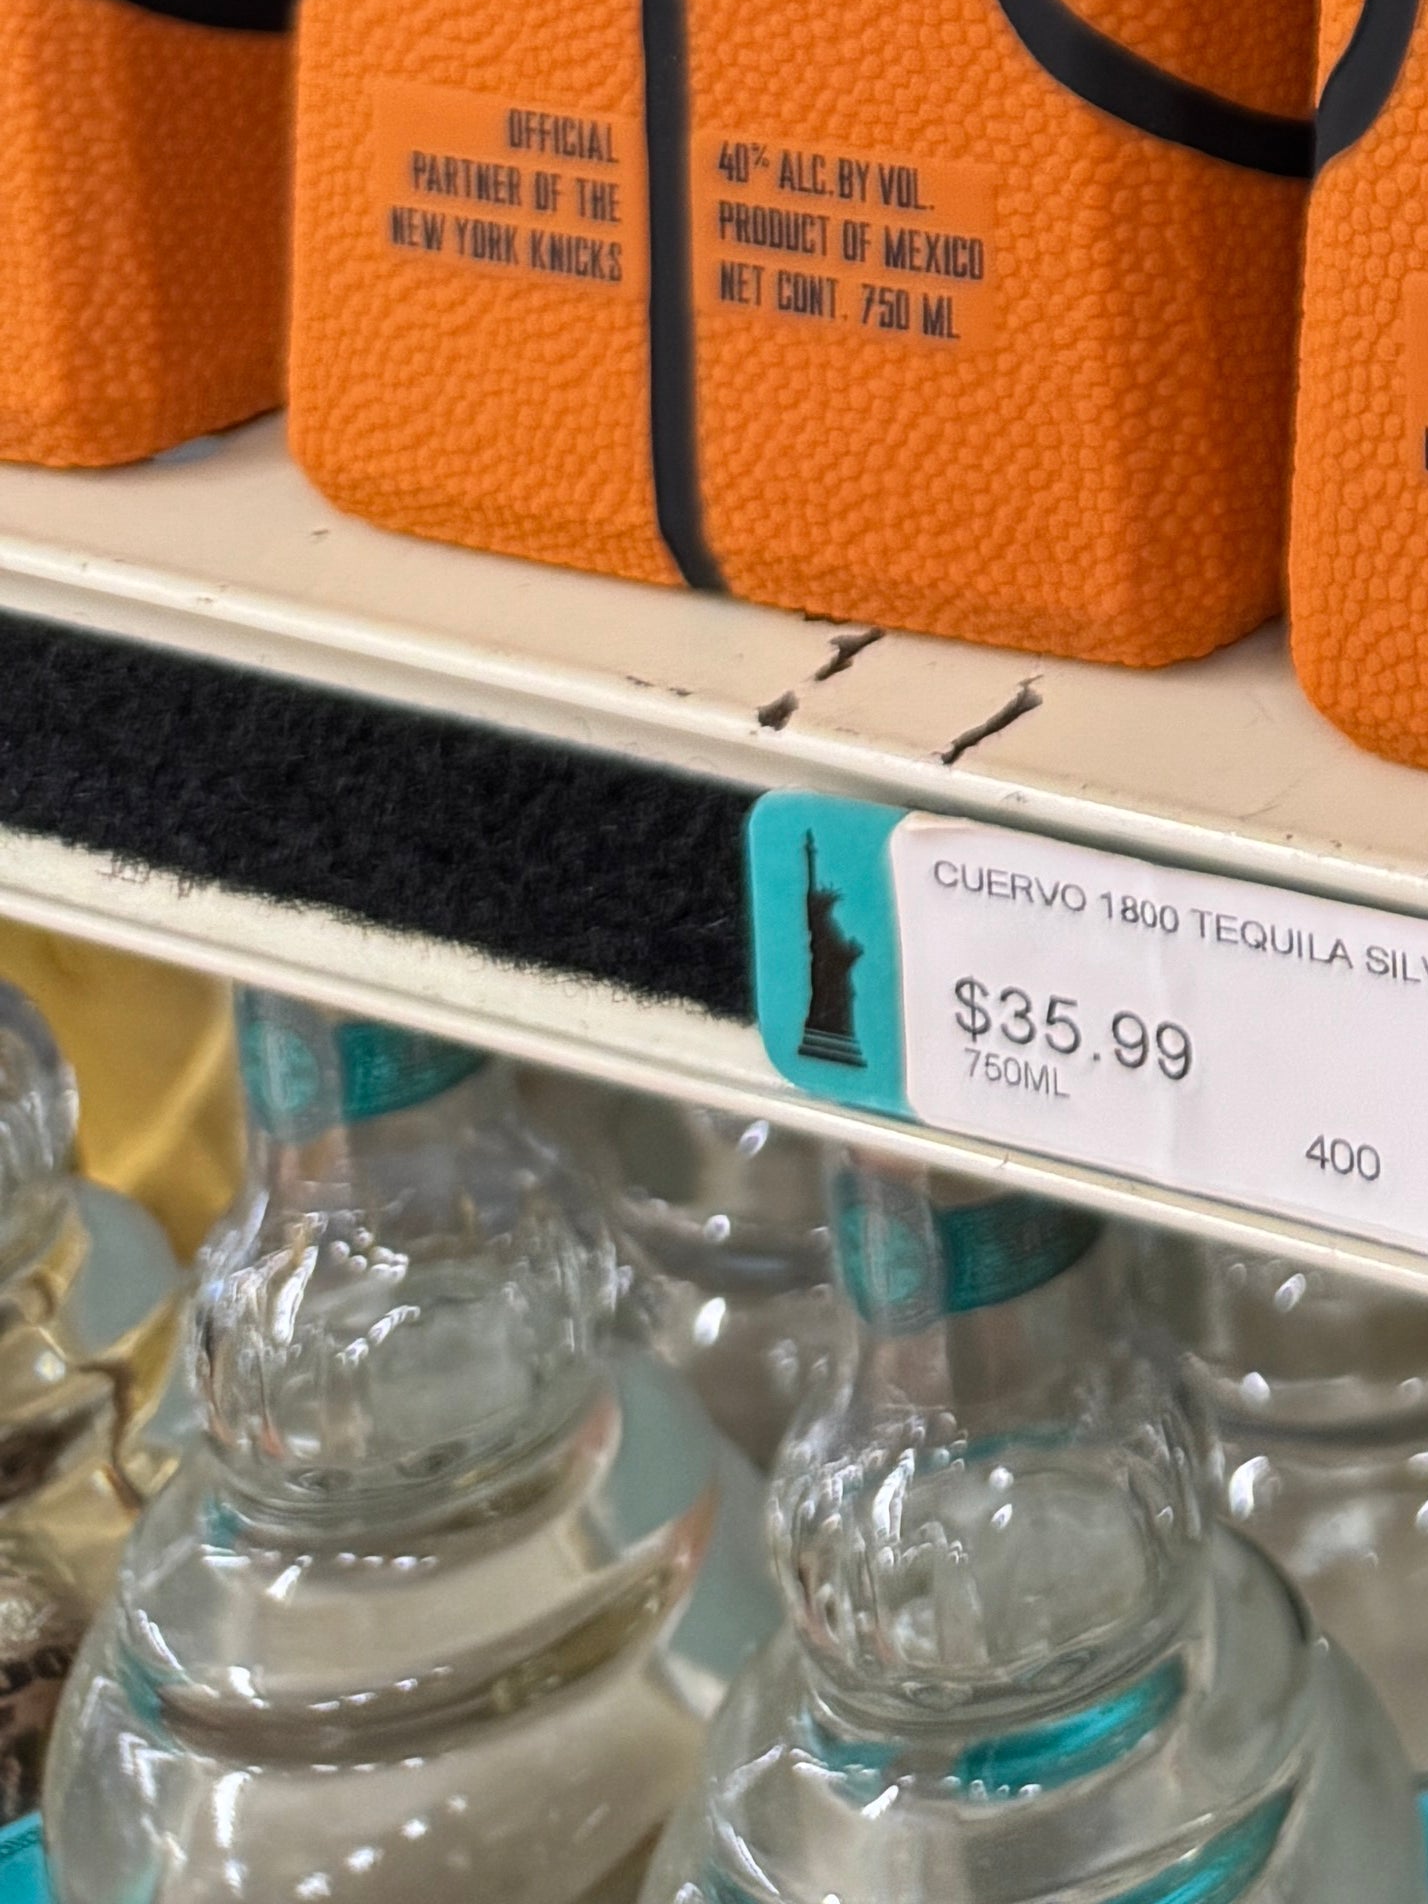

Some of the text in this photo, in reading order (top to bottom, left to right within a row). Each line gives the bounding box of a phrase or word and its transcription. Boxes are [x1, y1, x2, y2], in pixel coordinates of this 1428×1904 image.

[508, 108, 619, 164] OFFICIAL
[411, 150, 622, 224] PARTNER OF THE
[718, 140, 770, 184] 40%
[878, 166, 935, 211] VOL.
[389, 205, 623, 283] NEW YORK KNICKS
[718, 200, 984, 281] PRODUCT OF MEXICO
[719, 260, 764, 305] NET
[861, 283, 910, 331] 750
[921, 295, 960, 341] ML
[933, 859, 1087, 914] CUERVO
[1099, 892, 1180, 935] 1800
[1190, 908, 1355, 972] TEQUILA
[953, 974, 1194, 1082] $35.99
[963, 1047, 1071, 1099] 750ML
[1305, 1133, 1383, 1182] 400
